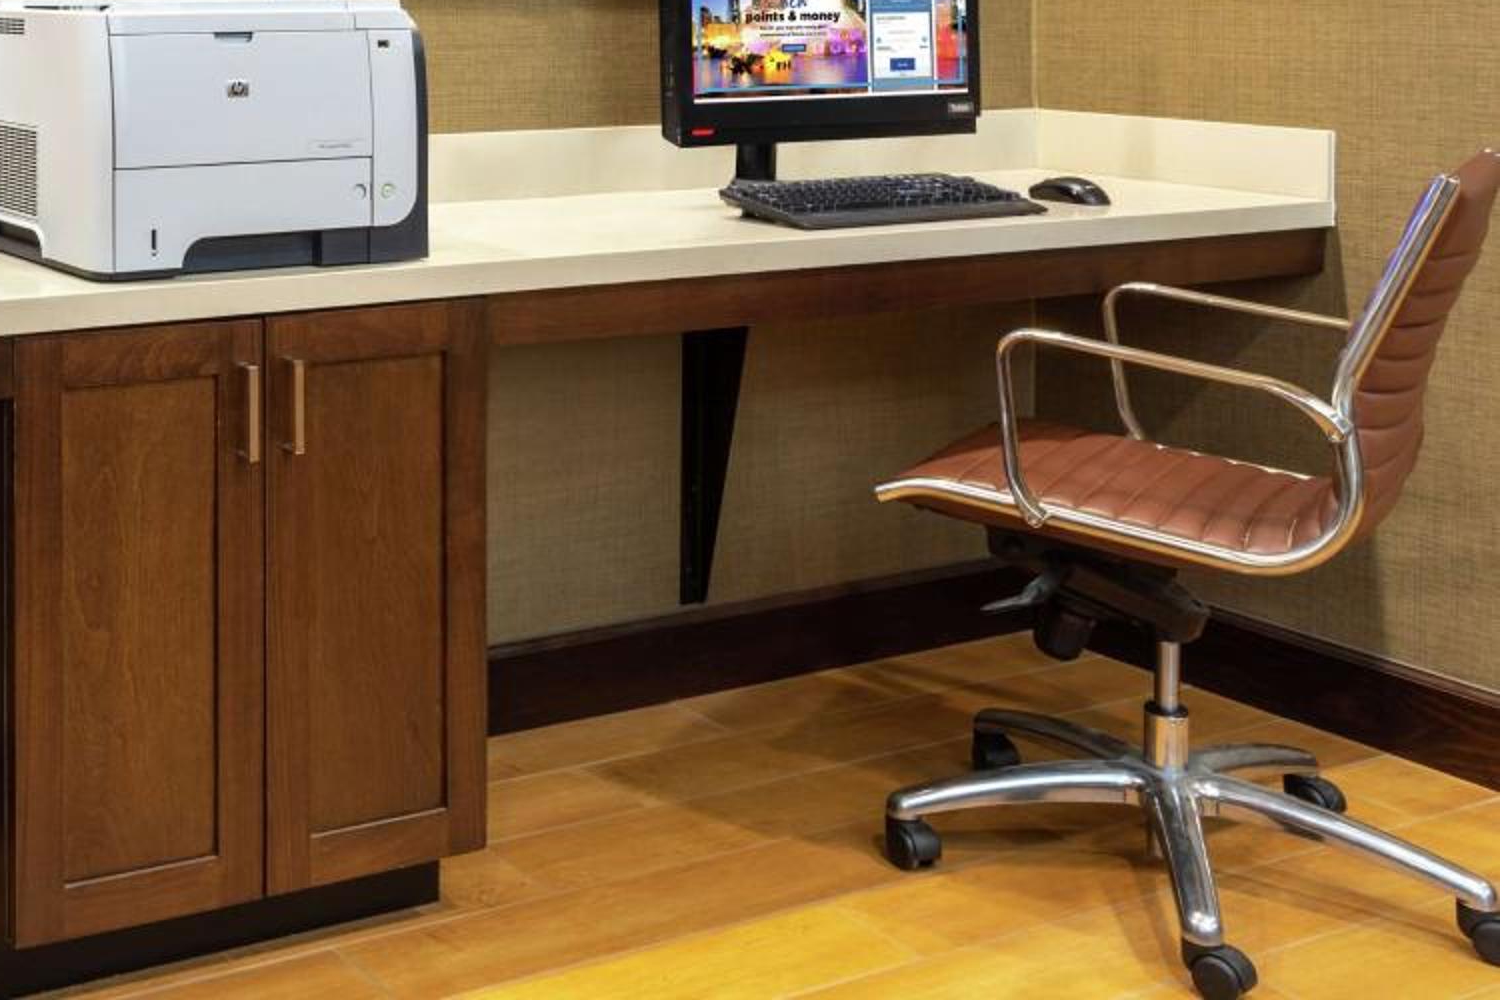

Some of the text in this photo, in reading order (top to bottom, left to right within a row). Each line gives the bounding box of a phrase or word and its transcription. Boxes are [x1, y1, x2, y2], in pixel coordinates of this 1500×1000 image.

[745, 11, 841, 23] points & money
